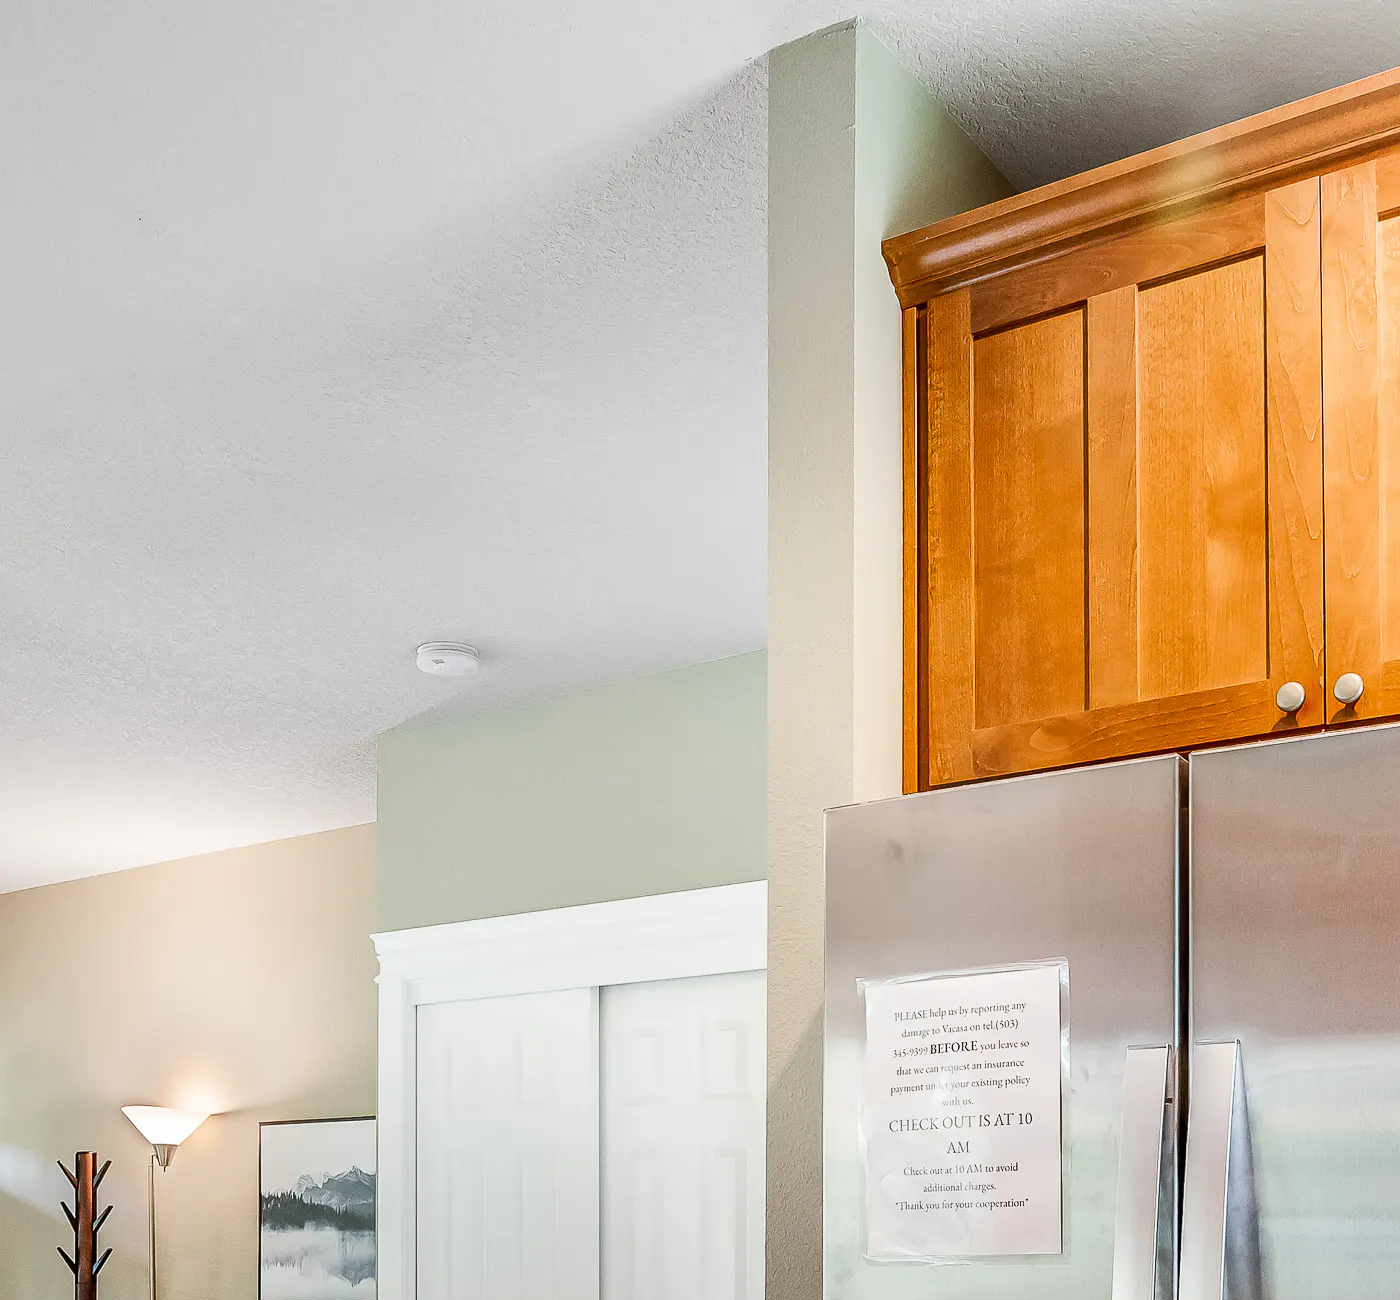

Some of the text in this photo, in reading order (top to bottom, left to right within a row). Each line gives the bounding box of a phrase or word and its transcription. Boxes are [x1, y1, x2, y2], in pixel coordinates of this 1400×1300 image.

[894, 1002, 1027, 1022] PLEASE help us by reporting any
[901, 1028, 930, 1039] damage
[942, 1024, 968, 1033] Vacasa
[983, 1019, 1019, 1031] tel.(503)
[892, 1039, 1030, 1059] 345-9399 BEFORE you leave so
[896, 1067, 912, 1076] that
[926, 1065, 939, 1073] can
[941, 1063, 970, 1075] request
[972, 1062, 982, 1070] an
[984, 1059, 1025, 1069] insurance
[890, 1083, 924, 1097] payment
[950, 1080, 969, 1093] your
[971, 1076, 1003, 1089] existing
[1005, 1075, 1031, 1087] policy
[942, 1097, 974, 1107] with us.
[889, 1112, 1033, 1133] CHECK OUT IS AT 10
[947, 1141, 971, 1154] AM
[903, 1162, 1019, 1177] Check out at 10 AM to avoid
[923, 1182, 997, 1193] additional charges.
[926, 1202, 940, 1213] you
[942, 1200, 954, 1210] for
[954, 1201, 973, 1212] your
